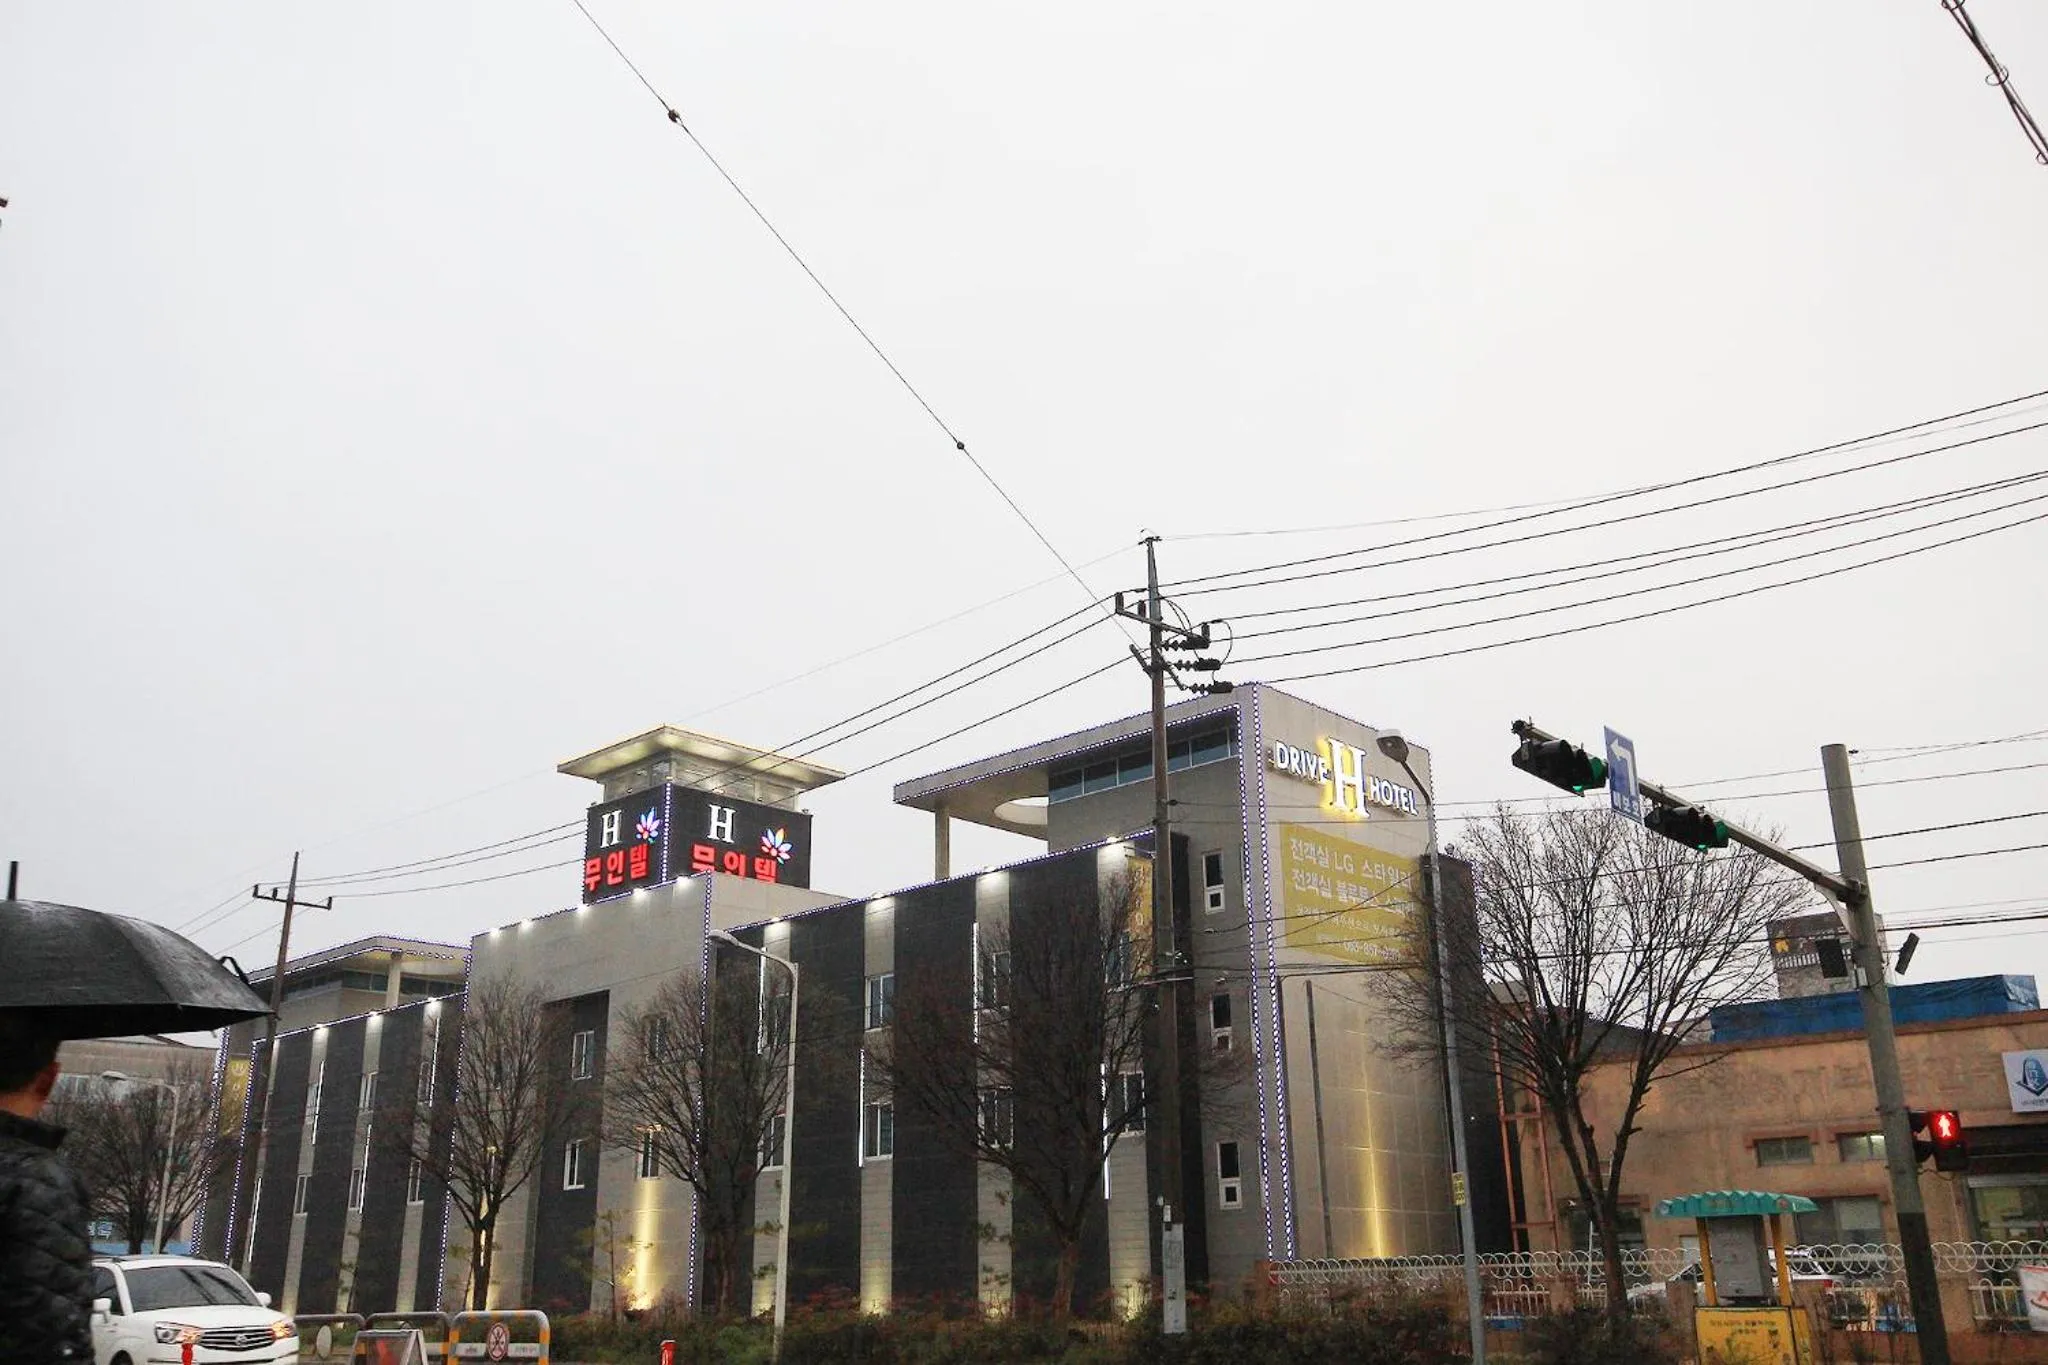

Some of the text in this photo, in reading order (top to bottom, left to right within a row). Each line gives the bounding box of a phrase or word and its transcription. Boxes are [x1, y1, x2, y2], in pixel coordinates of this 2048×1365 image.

[1275, 737, 1418, 818] DRIVE H HOTEL
[601, 809, 623, 847] H
[707, 803, 736, 843] H
[585, 843, 650, 891] 무인텔
[1334, 851, 1354, 875] LG
